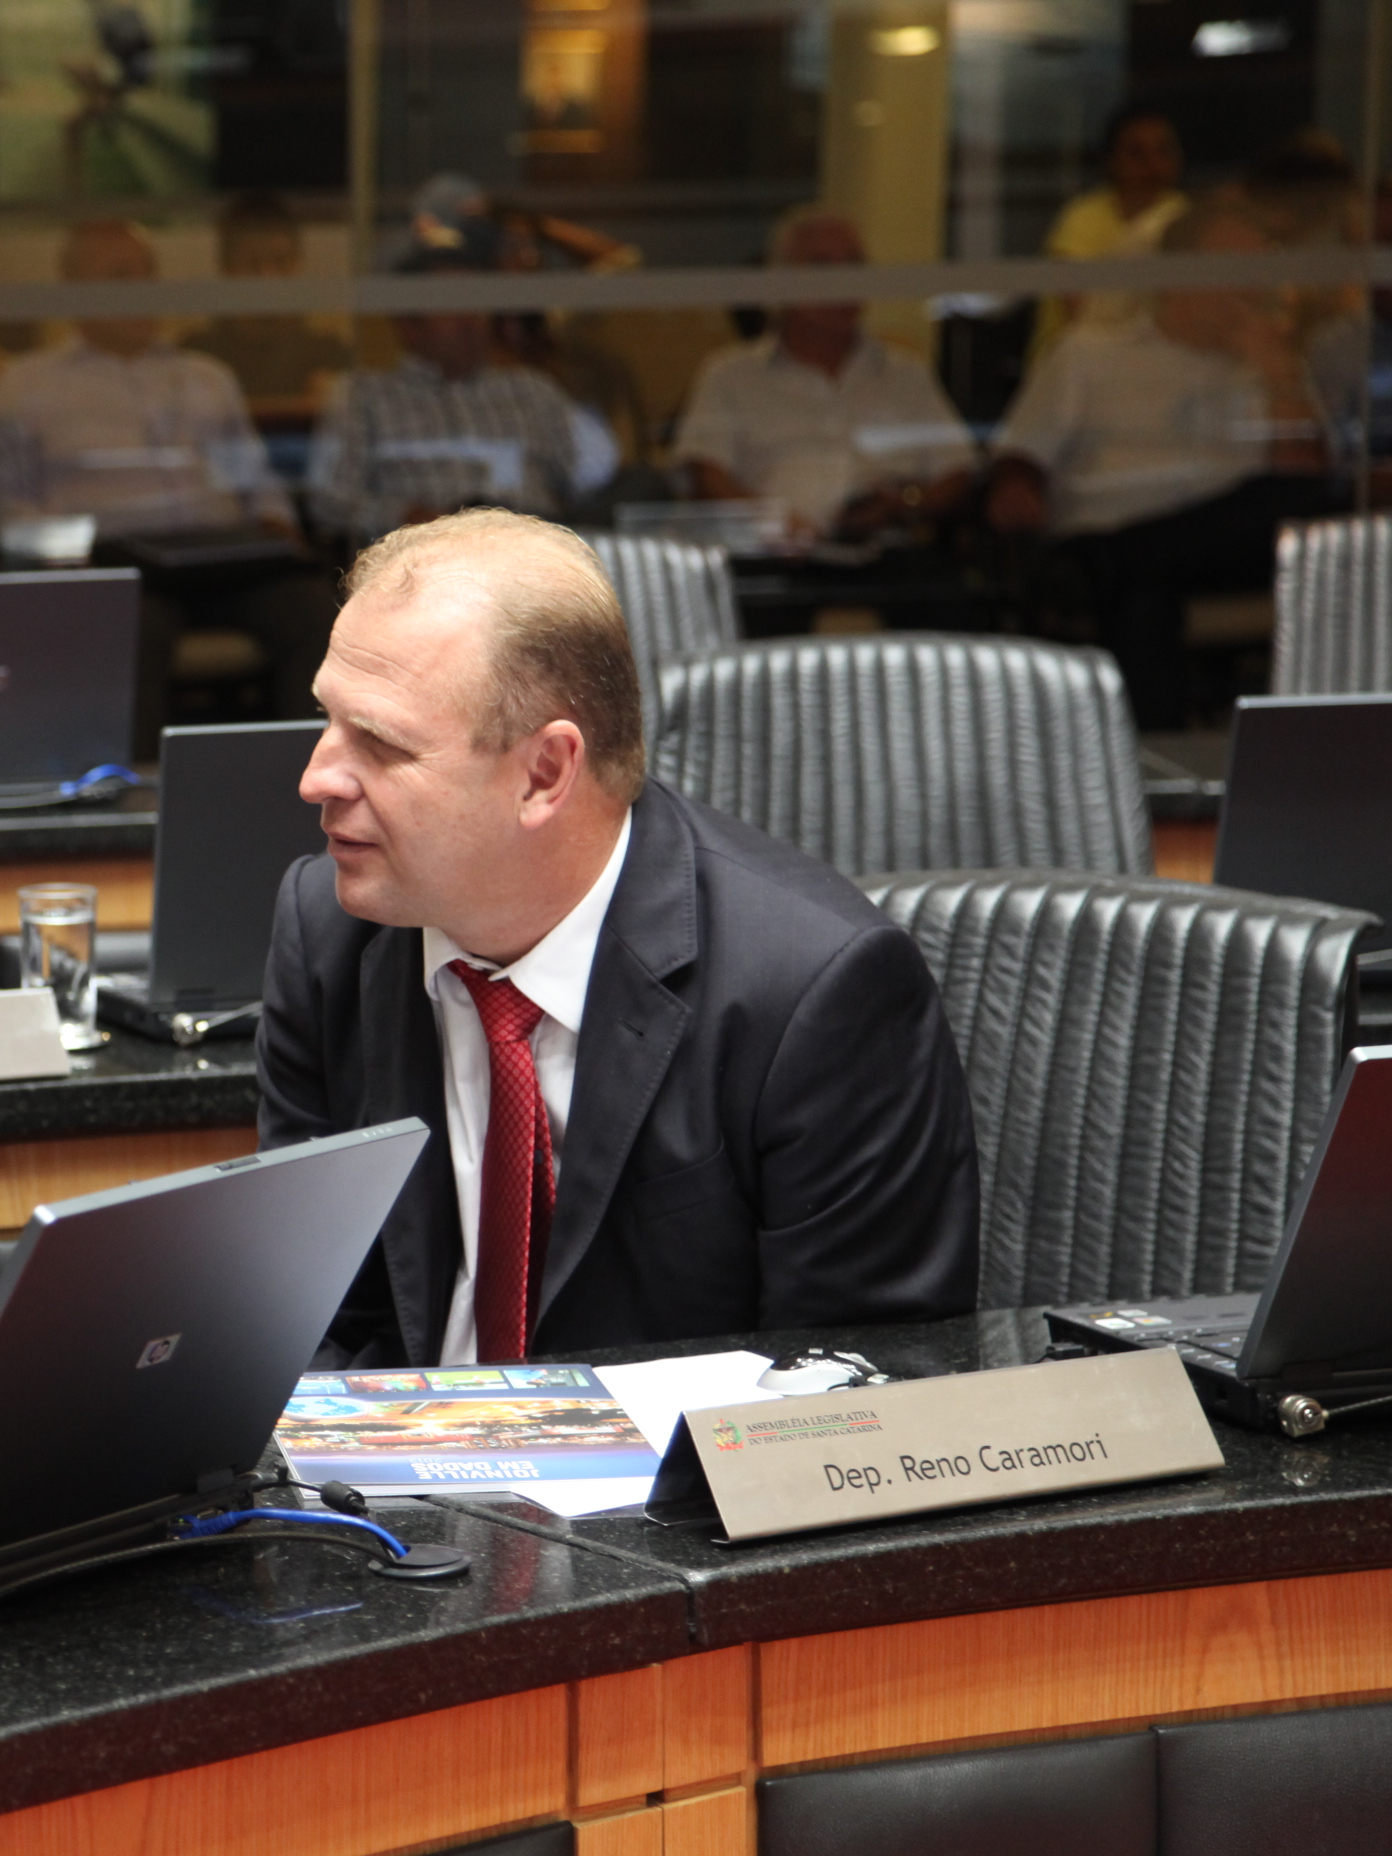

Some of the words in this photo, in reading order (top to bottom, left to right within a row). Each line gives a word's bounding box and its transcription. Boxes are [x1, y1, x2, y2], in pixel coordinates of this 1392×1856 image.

[810, 1410, 878, 1425] LEGISLATIVA
[749, 1437, 763, 1446] DO
[765, 1434, 798, 1444] ESTADO
[799, 1432, 810, 1440] DE
[811, 1429, 839, 1440] SANTA
[840, 1424, 883, 1436] CATARINA
[410, 1461, 492, 1472] DADOS
[496, 1460, 535, 1470] EM
[823, 1463, 893, 1494] Dep.
[899, 1454, 971, 1482] Reno
[978, 1433, 1108, 1473] Caramori
[415, 1469, 540, 1480] JOINVILLE
